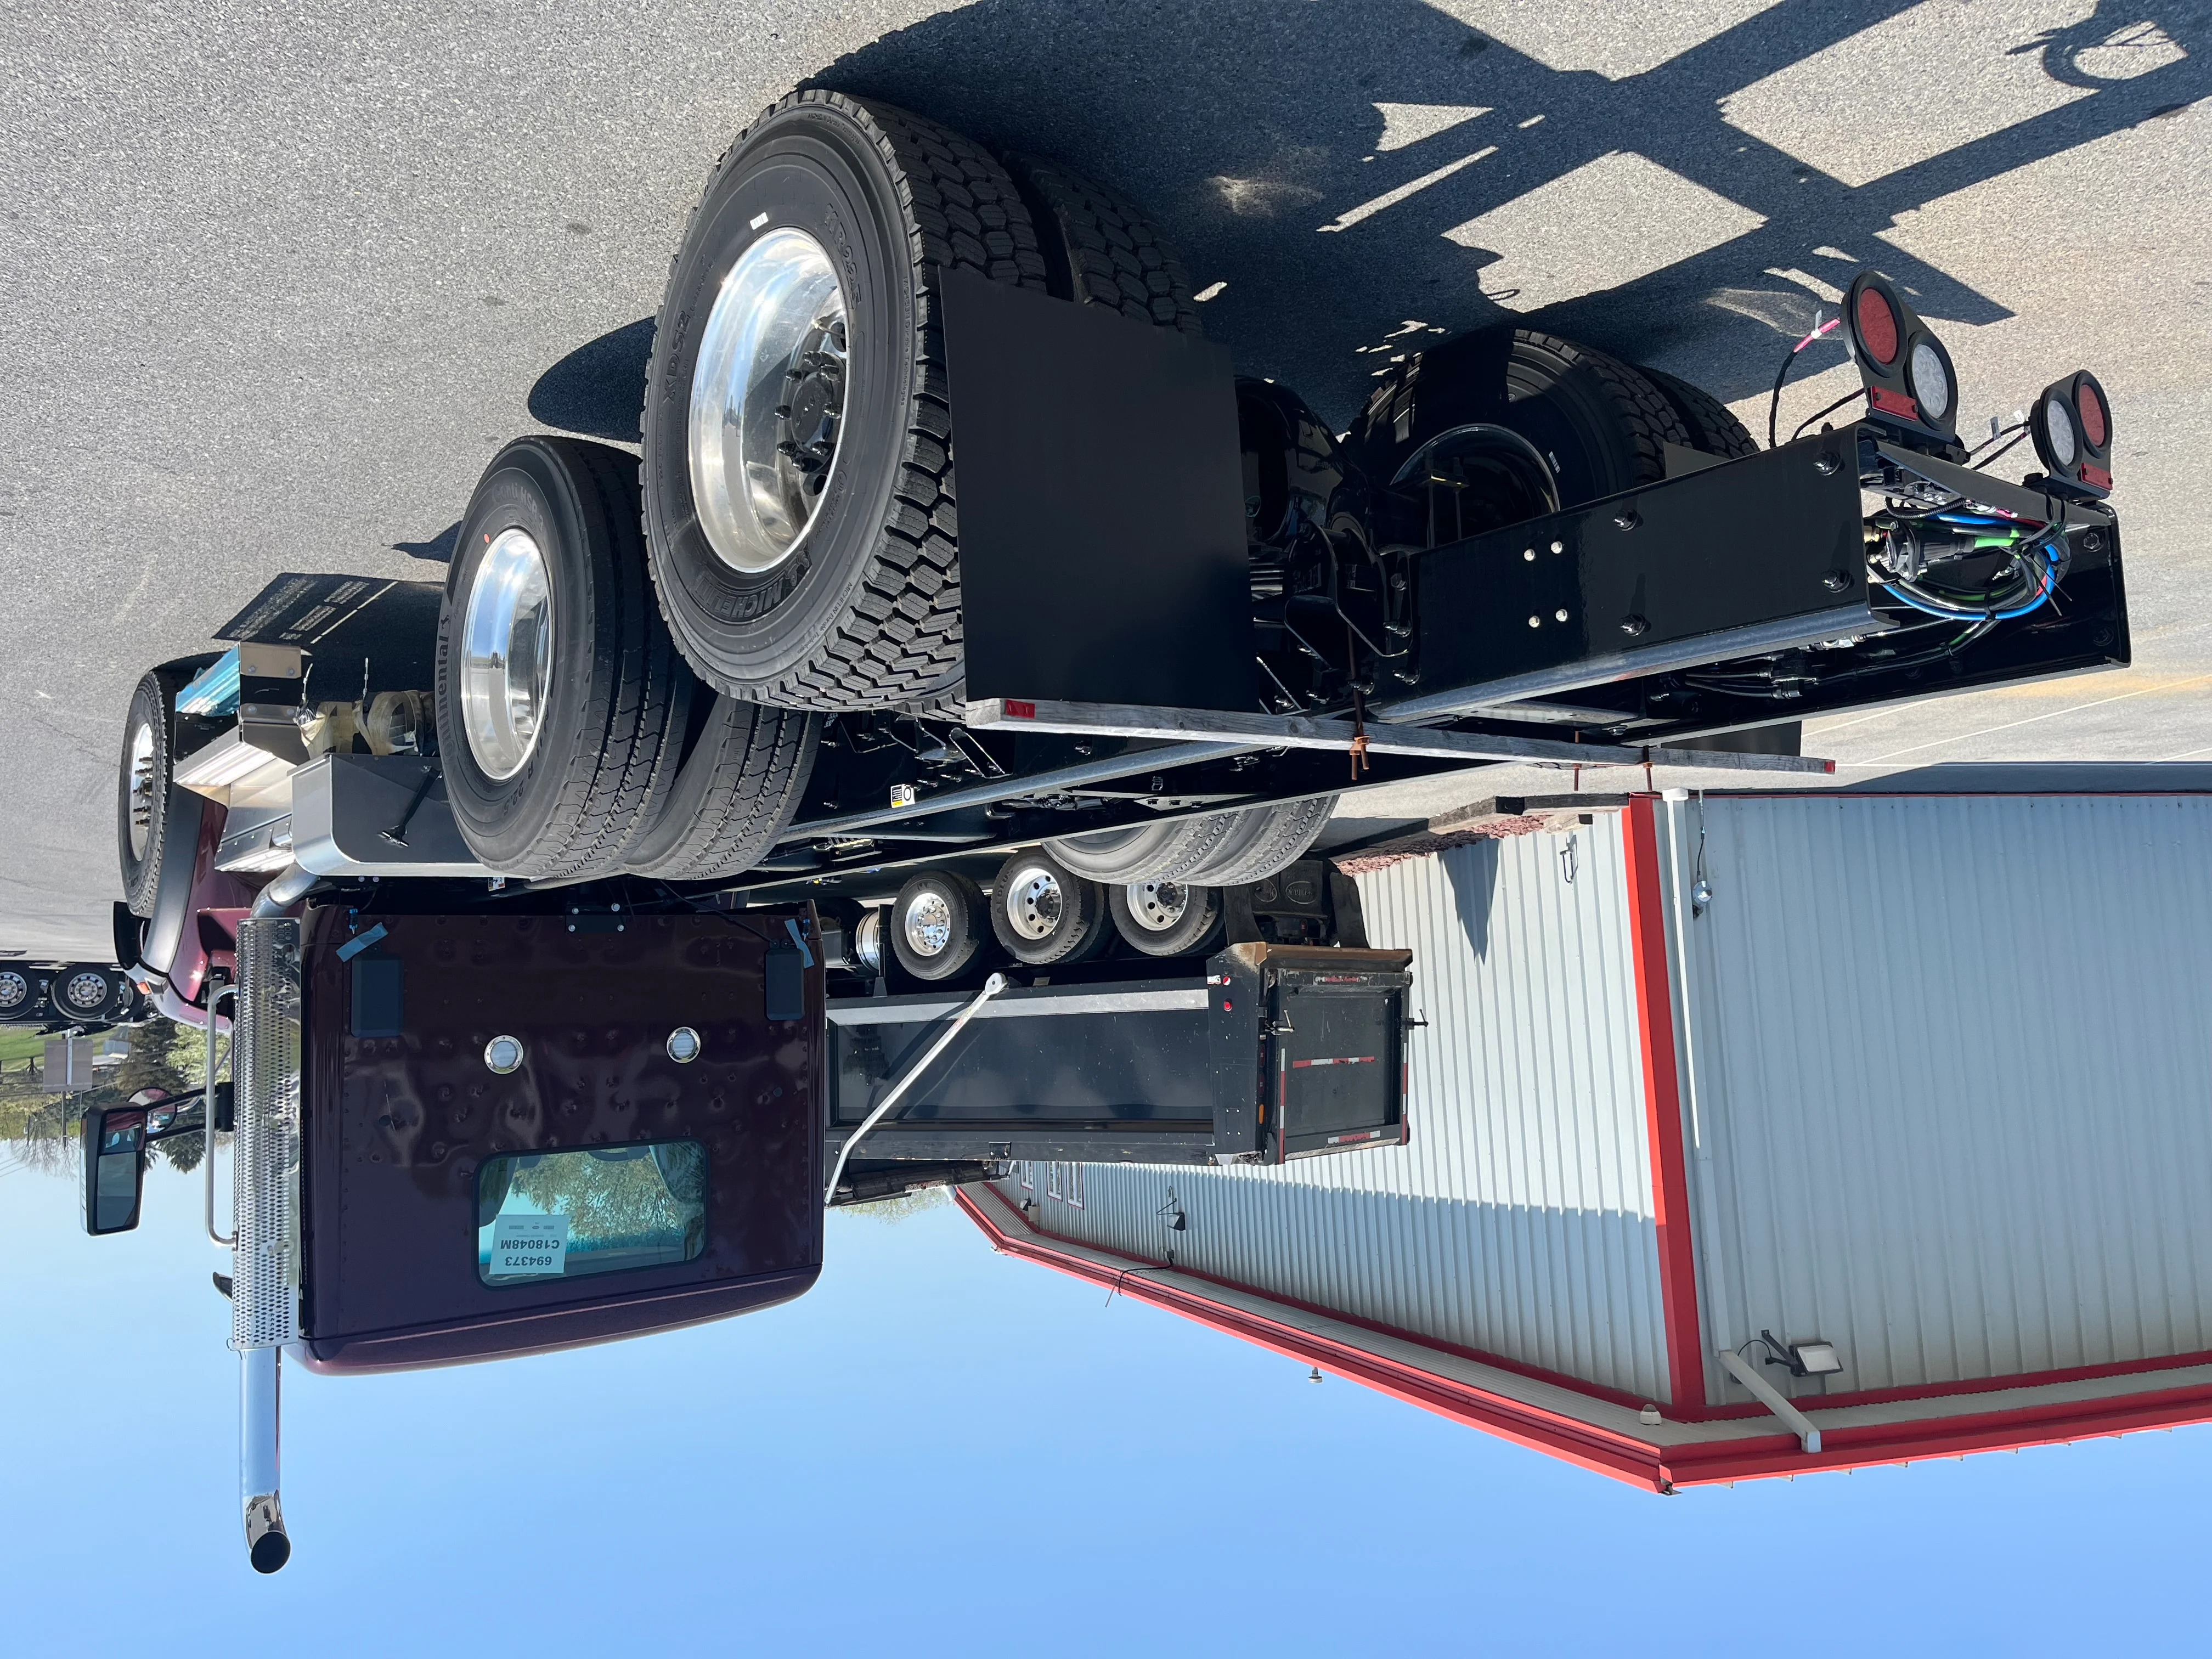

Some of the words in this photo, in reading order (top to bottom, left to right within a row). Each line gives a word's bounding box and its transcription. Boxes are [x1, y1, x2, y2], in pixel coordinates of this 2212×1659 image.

[662, 310, 691, 404] XDS2
[693, 577, 783, 618] MICHELIN
[832, 582, 853, 614] MICHELIN
[819, 612, 834, 631] Durable
[437, 635, 455, 765] Continental
[995, 869, 1014, 914] AEOLUS
[500, 1240, 560, 1250] C18048M
[505, 1256, 552, 1266] 694373
